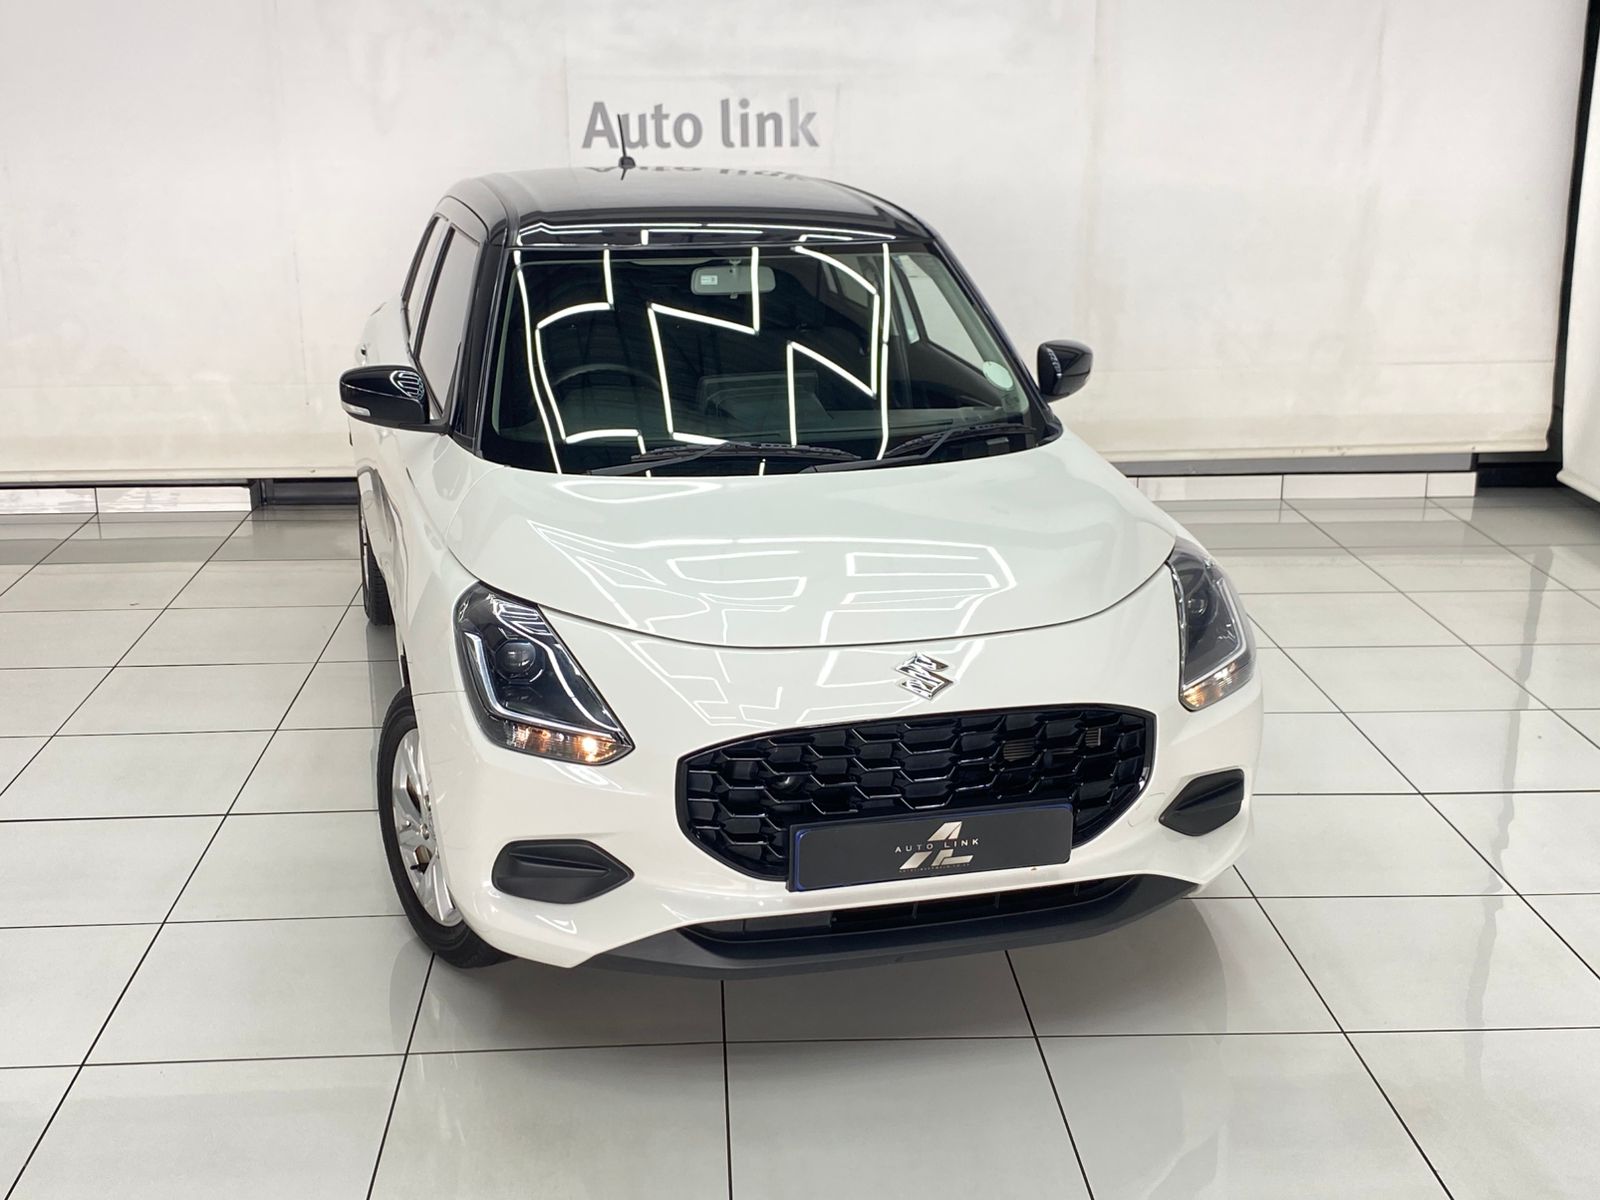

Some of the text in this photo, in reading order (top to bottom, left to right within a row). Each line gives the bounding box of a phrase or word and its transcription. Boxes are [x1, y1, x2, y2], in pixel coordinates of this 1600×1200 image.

[581, 96, 819, 149] Auto link
[894, 838, 979, 853] AUTO LINK
